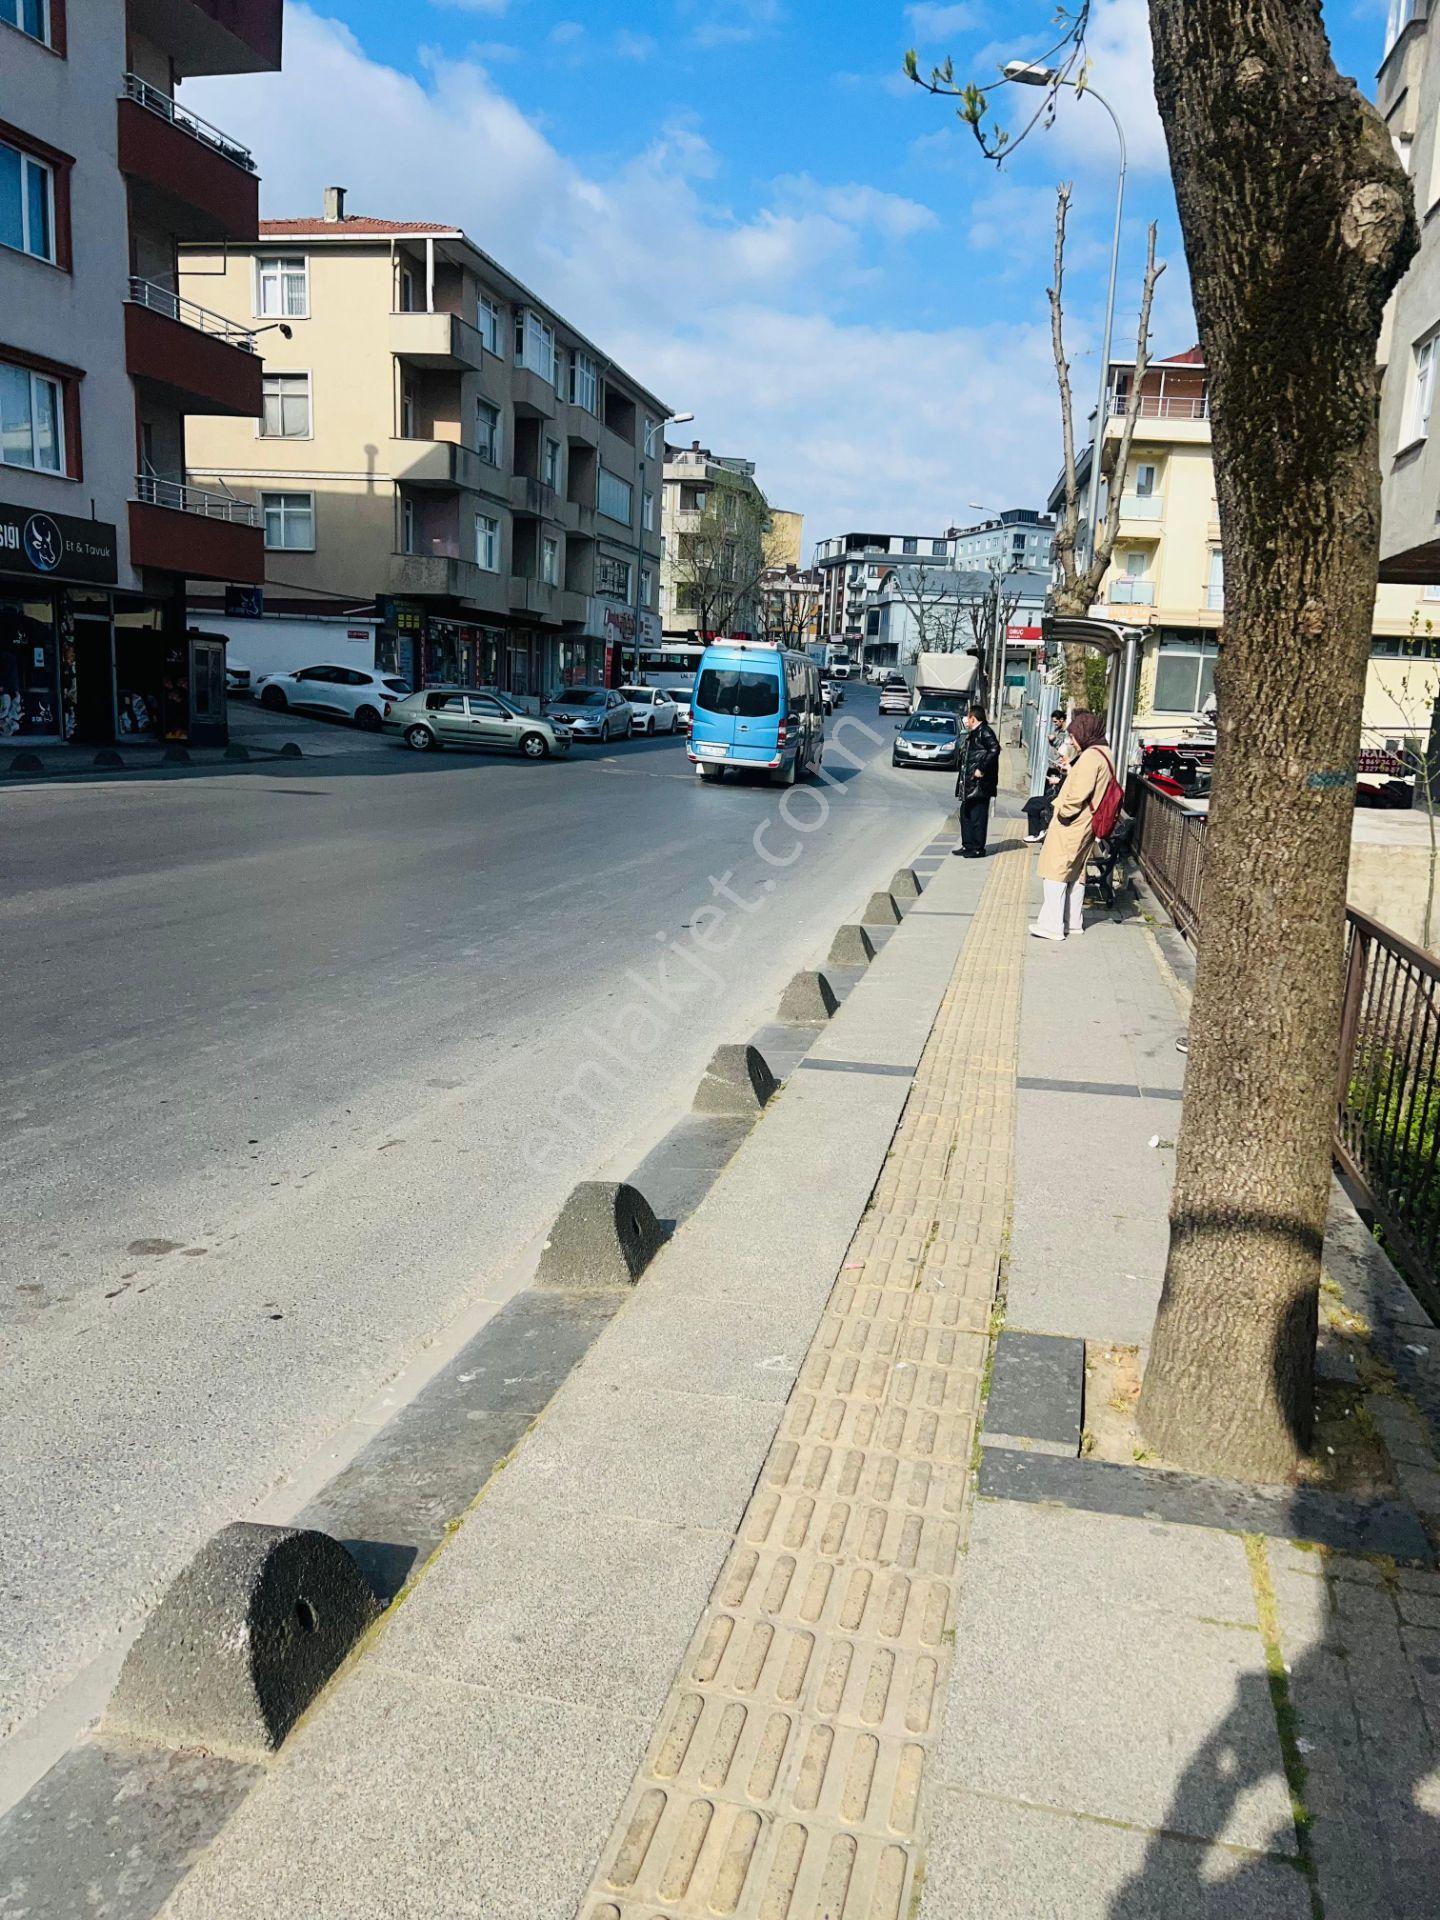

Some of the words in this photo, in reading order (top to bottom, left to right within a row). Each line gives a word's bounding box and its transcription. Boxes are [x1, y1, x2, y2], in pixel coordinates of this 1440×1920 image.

[66, 540, 74, 552] Et
[75, 542, 83, 554] &
[85, 543, 110, 557] Tavuk
